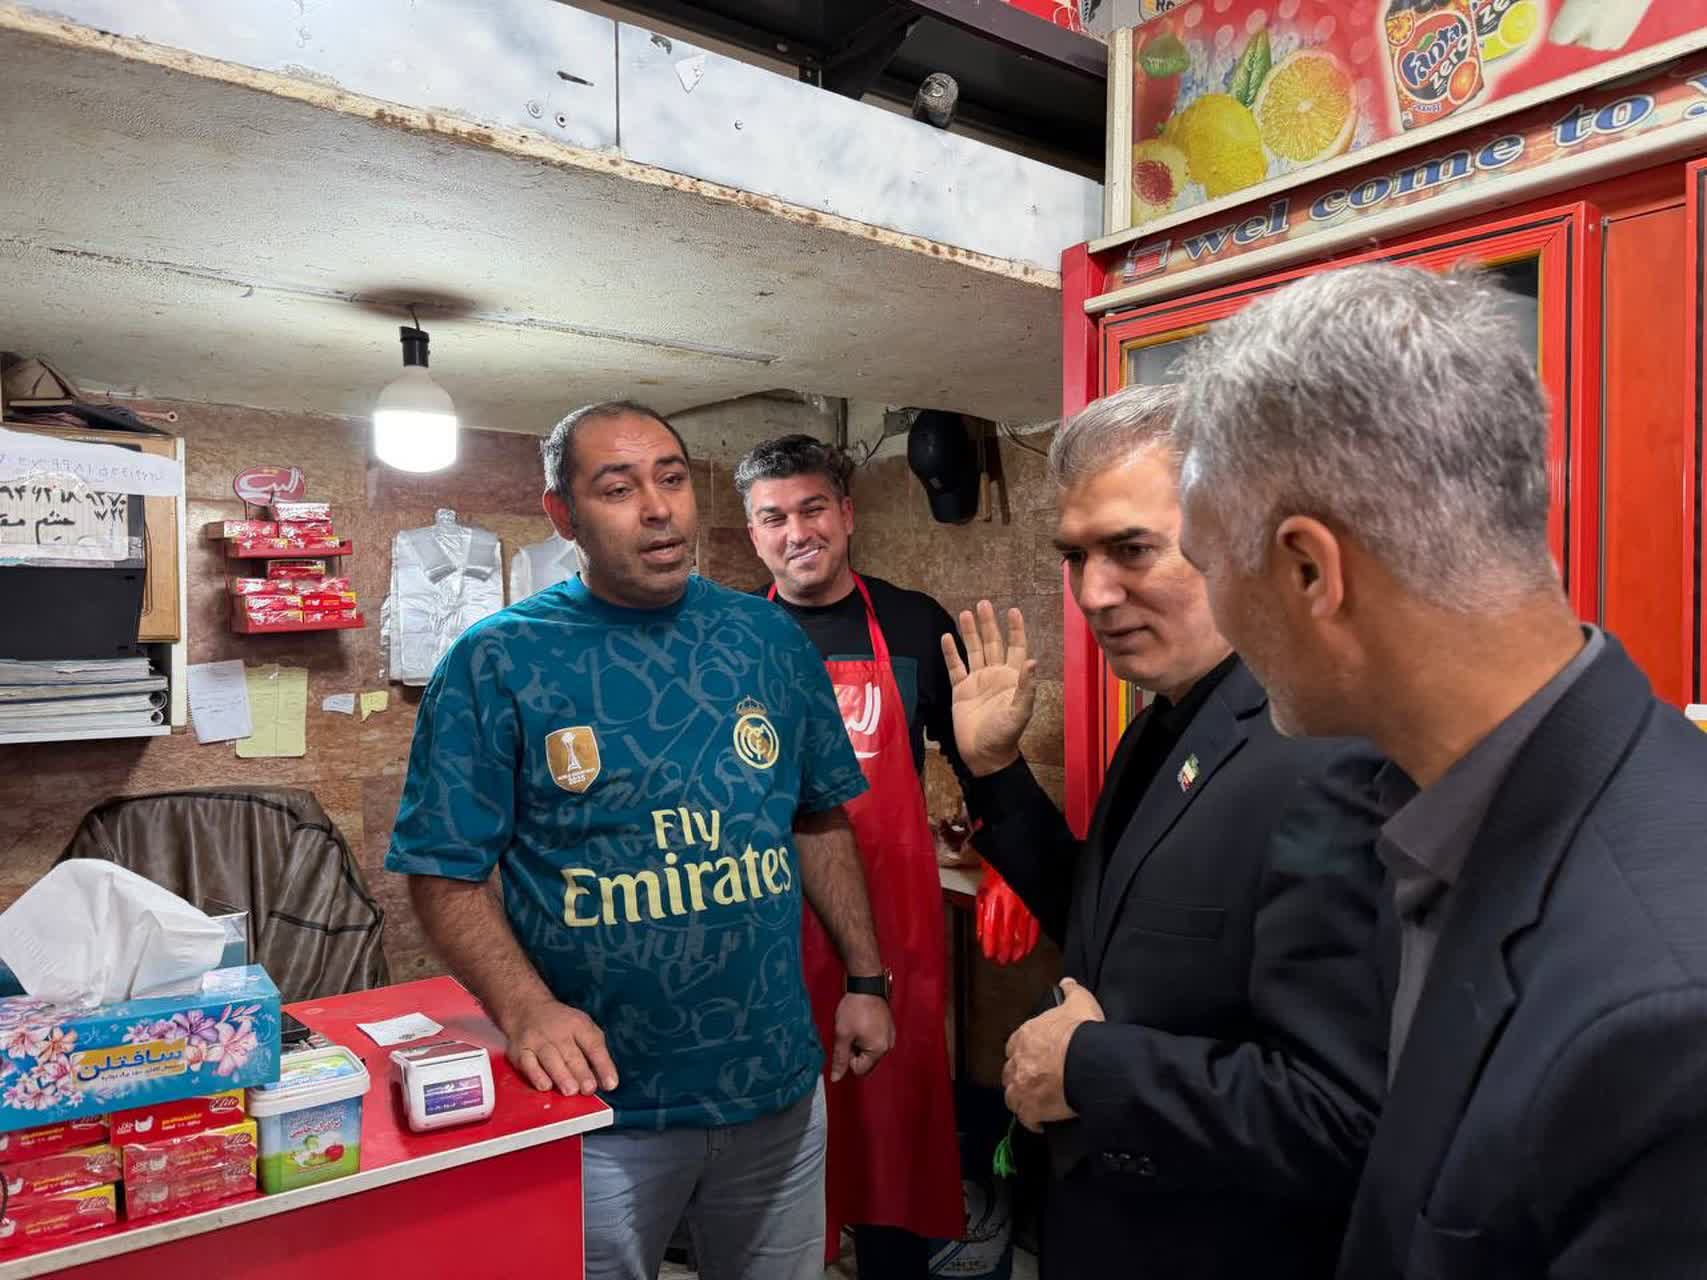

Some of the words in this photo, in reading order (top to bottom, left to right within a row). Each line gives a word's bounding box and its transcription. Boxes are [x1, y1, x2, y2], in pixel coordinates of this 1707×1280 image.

[1429, 33, 1470, 90] zero
[1182, 200, 1289, 261] wel
[1308, 133, 1526, 222] come
[1552, 93, 1656, 148] to
[651, 806, 722, 850] Fly
[561, 841, 792, 928] Emirates
